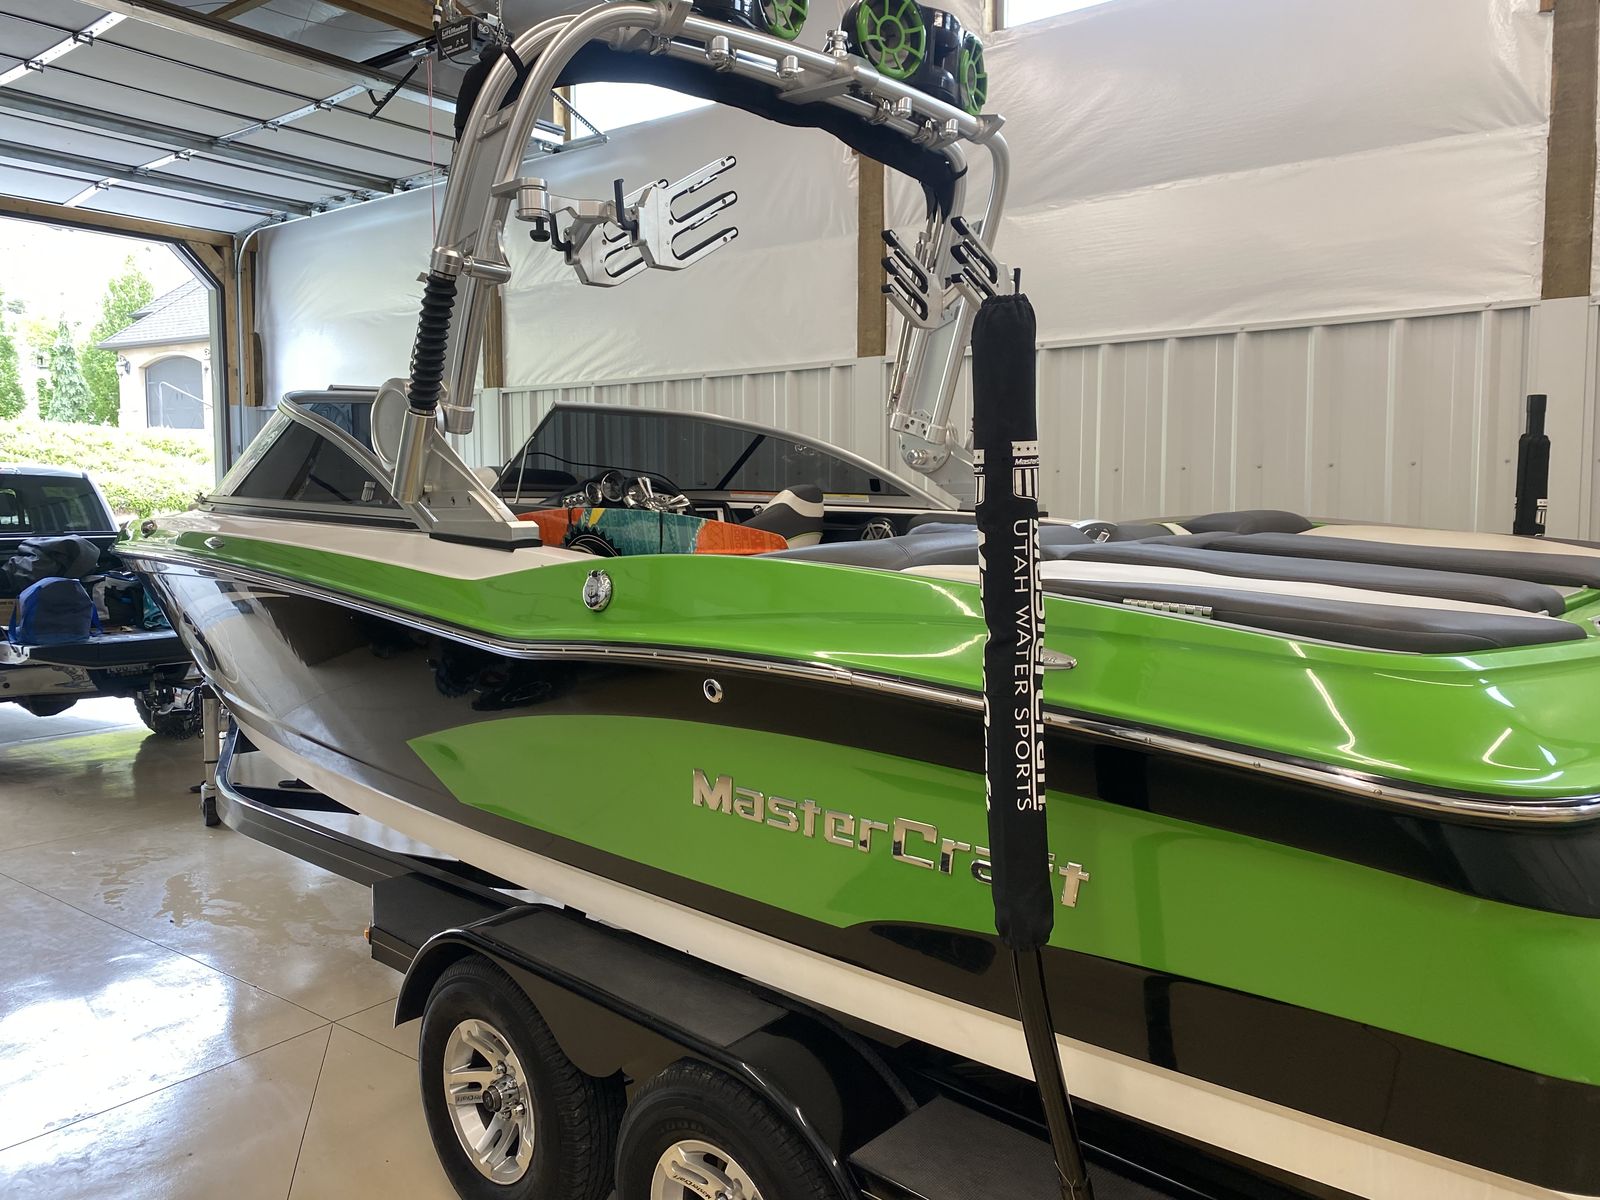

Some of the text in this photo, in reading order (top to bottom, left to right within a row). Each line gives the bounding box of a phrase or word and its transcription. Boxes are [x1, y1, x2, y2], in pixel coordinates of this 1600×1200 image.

[1013, 519, 1032, 811] UTAH WATER SPORTS
[691, 767, 1091, 909] MasterCrat
